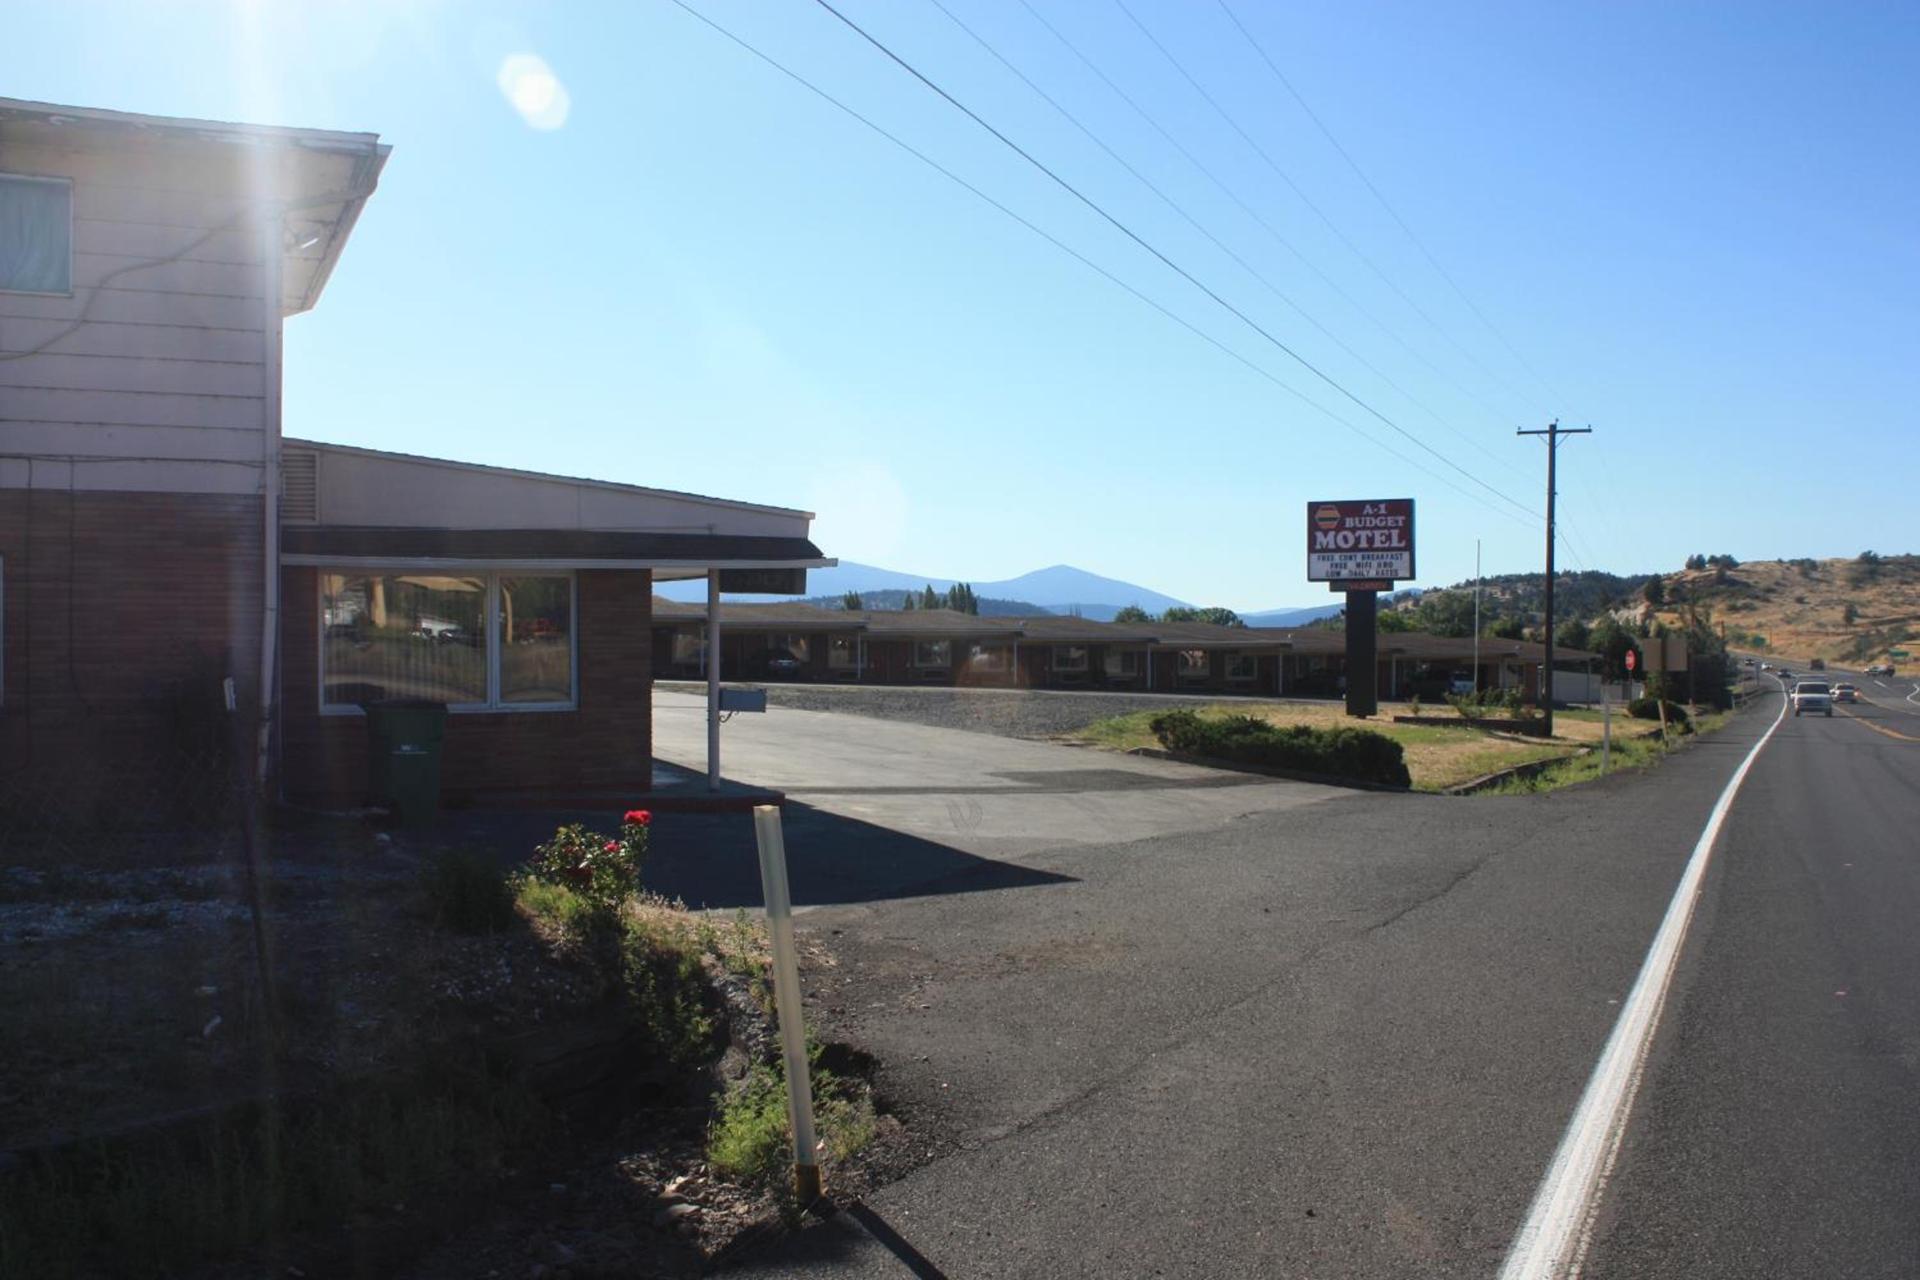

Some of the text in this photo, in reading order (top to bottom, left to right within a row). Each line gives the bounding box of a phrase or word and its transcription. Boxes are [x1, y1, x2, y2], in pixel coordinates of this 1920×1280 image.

[1363, 503, 1387, 515] A-1
[1345, 516, 1406, 528] BUDGET
[1314, 529, 1406, 550] MOTEL
[1361, 553, 1403, 561] BREAKFAST
